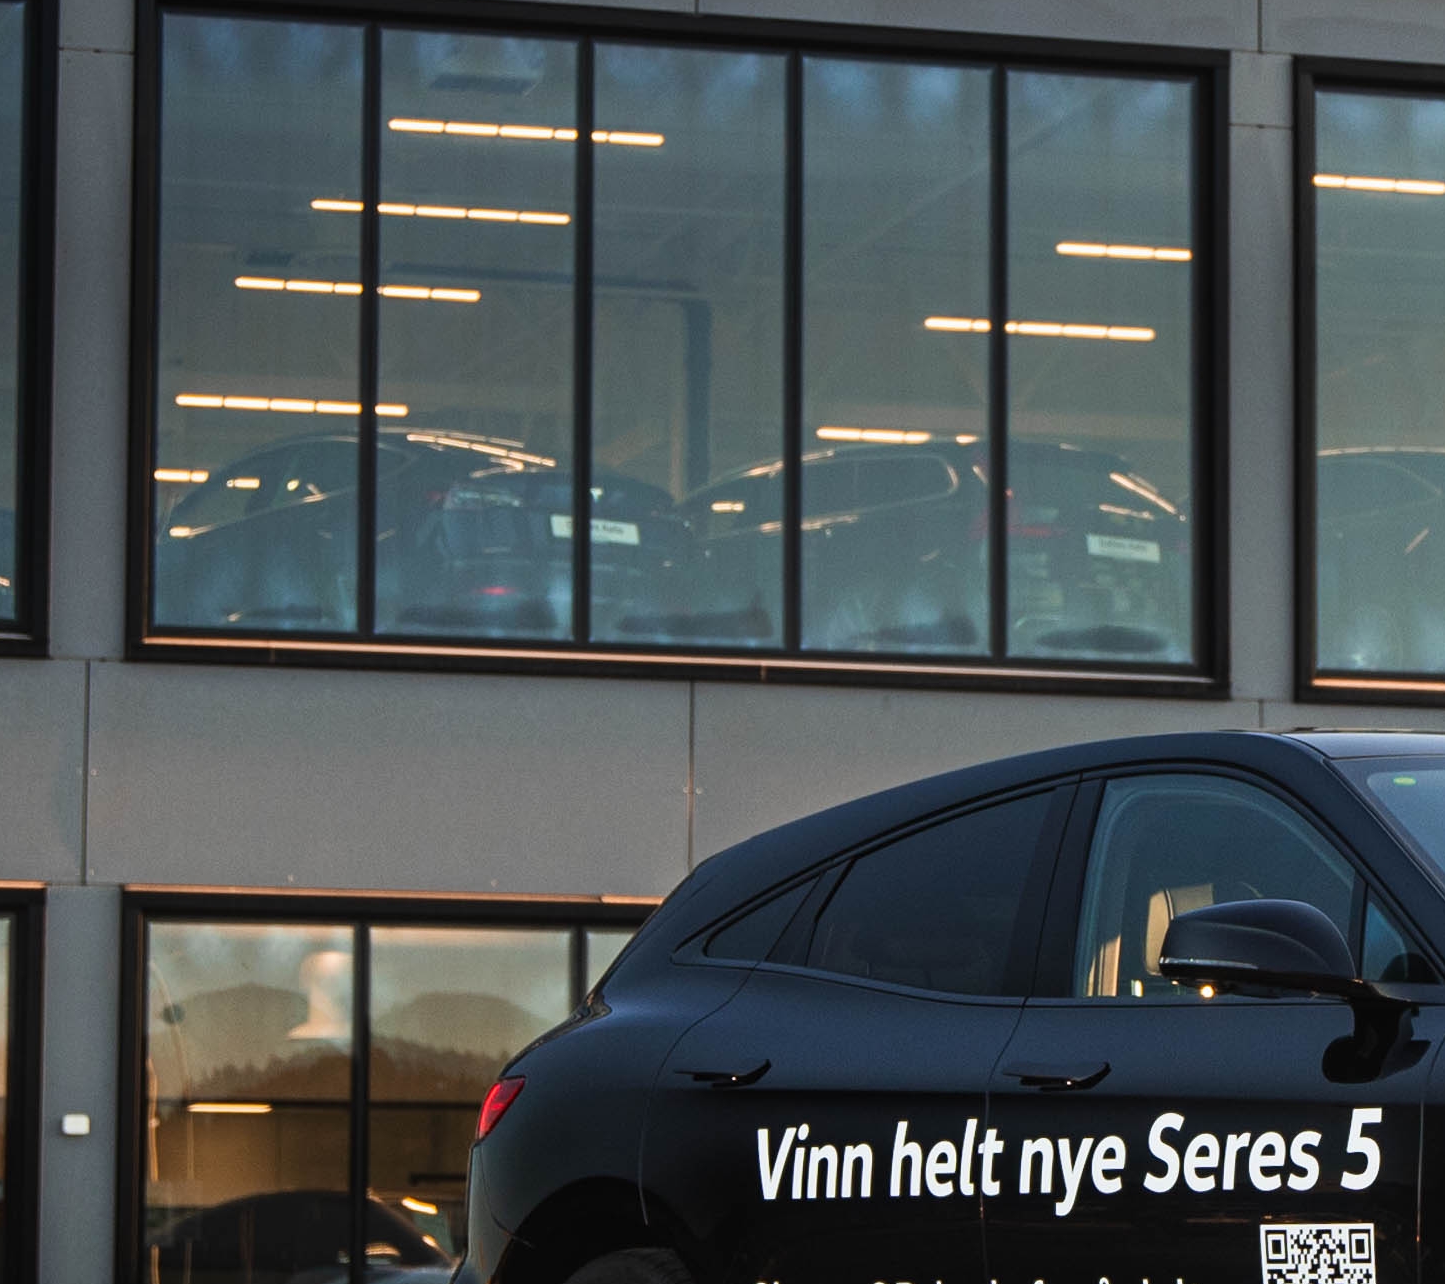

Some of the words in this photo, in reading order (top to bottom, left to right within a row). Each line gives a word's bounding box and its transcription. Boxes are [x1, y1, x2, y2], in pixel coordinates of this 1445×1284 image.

[757, 1123, 873, 1200] Vinn
[889, 1118, 1005, 1197] helt
[1019, 1135, 1127, 1217] nye
[1143, 1112, 1322, 1193] Seres
[1340, 1107, 1383, 1191] 5
